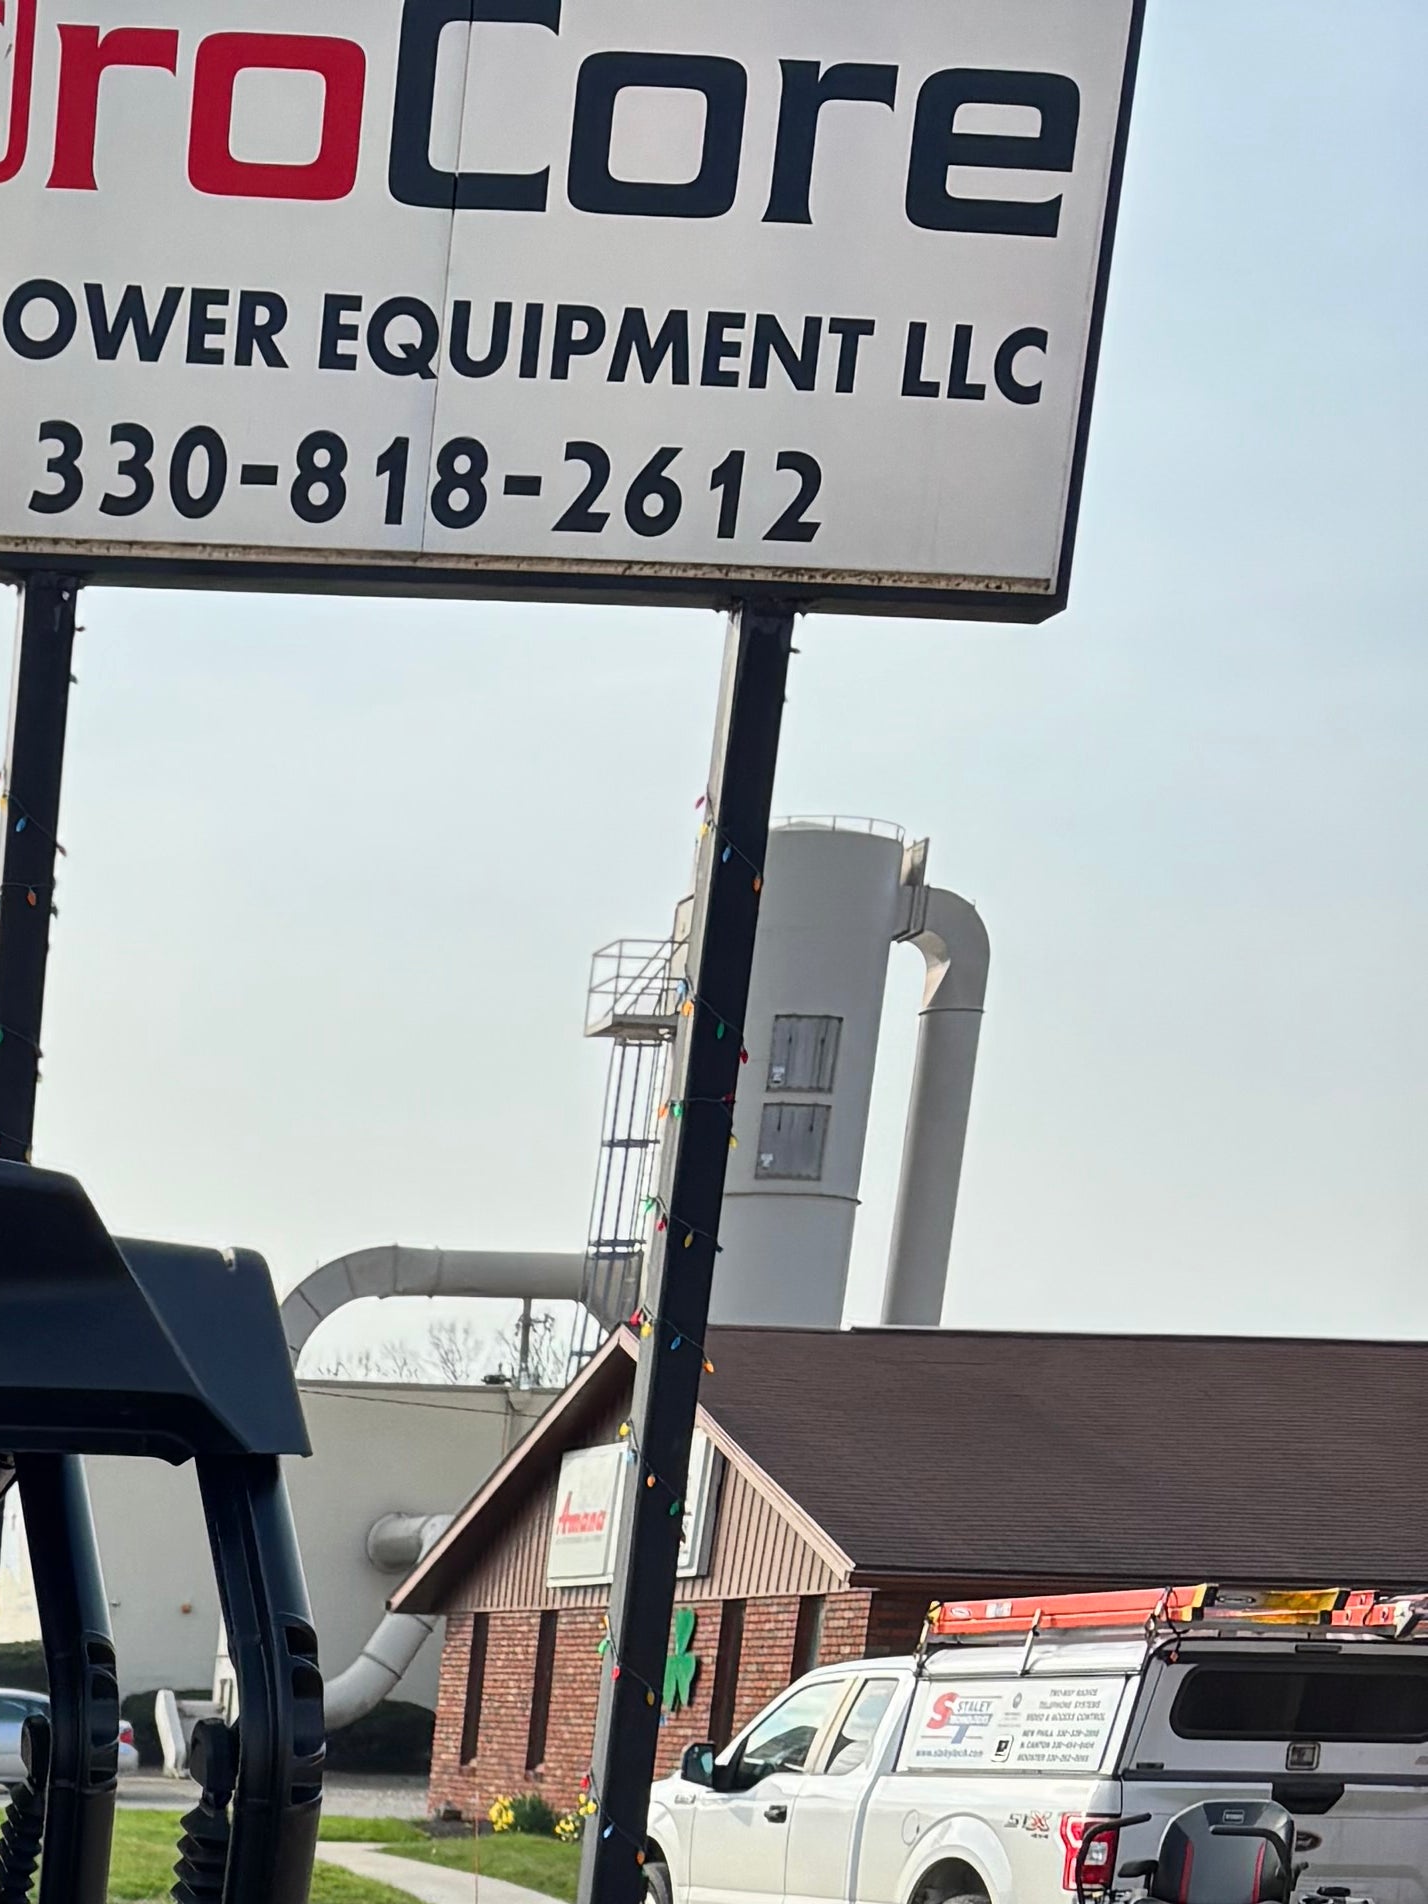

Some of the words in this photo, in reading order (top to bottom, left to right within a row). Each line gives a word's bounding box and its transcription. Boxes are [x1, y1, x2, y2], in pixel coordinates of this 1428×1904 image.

[318, 293, 876, 394] EQUIPMENT
[900, 321, 1049, 405] LLC
[28, 419, 822, 543] 330-818-2612
[556, 1490, 606, 1535] Amana
[957, 1701, 993, 1712] STALEY
